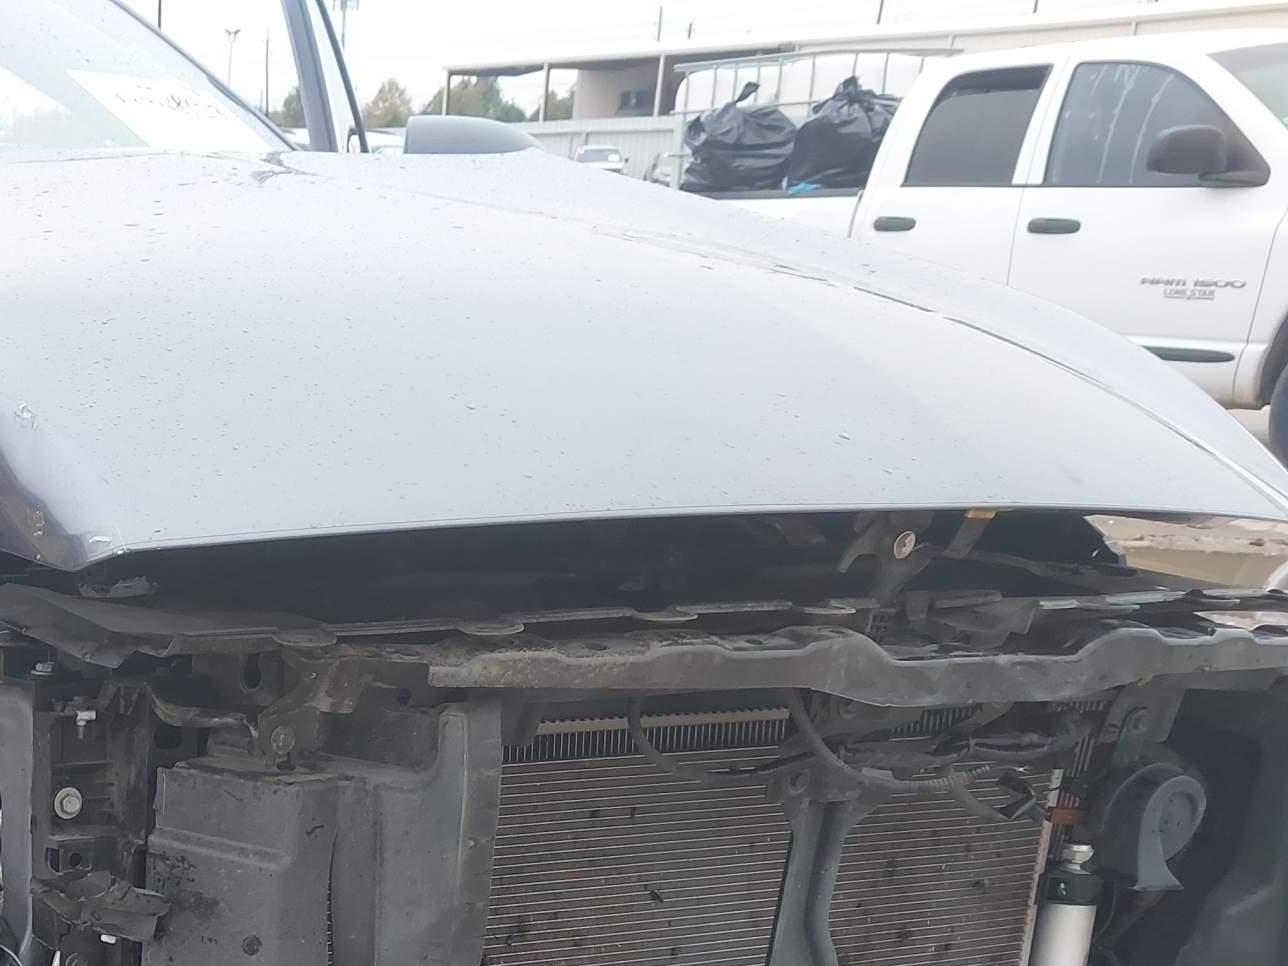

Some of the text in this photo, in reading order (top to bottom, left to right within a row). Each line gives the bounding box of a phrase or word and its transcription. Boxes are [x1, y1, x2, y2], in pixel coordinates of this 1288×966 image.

[1193, 279, 1247, 289] 1500
[1163, 287, 1215, 297] LONE STAR
